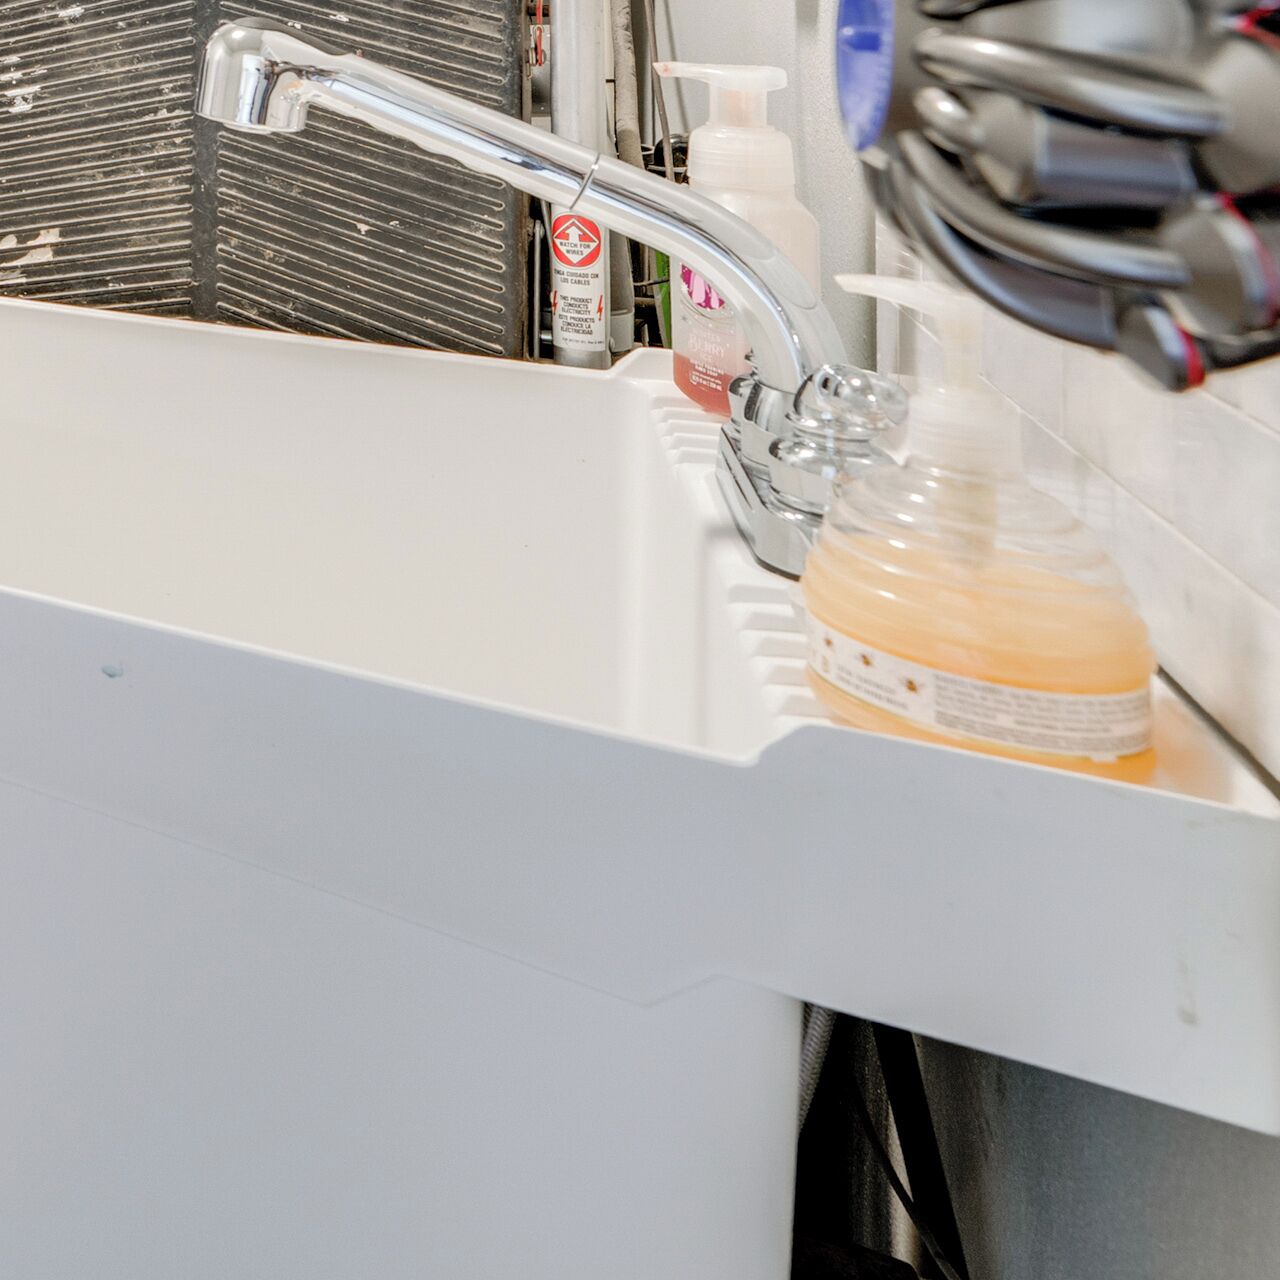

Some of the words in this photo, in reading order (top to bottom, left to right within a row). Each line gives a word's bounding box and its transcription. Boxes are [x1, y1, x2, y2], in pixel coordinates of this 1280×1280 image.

[570, 296, 592, 304] PRODUCT
[563, 301, 589, 310] CONDUCTS
[561, 307, 591, 315] ELECTRICITY
